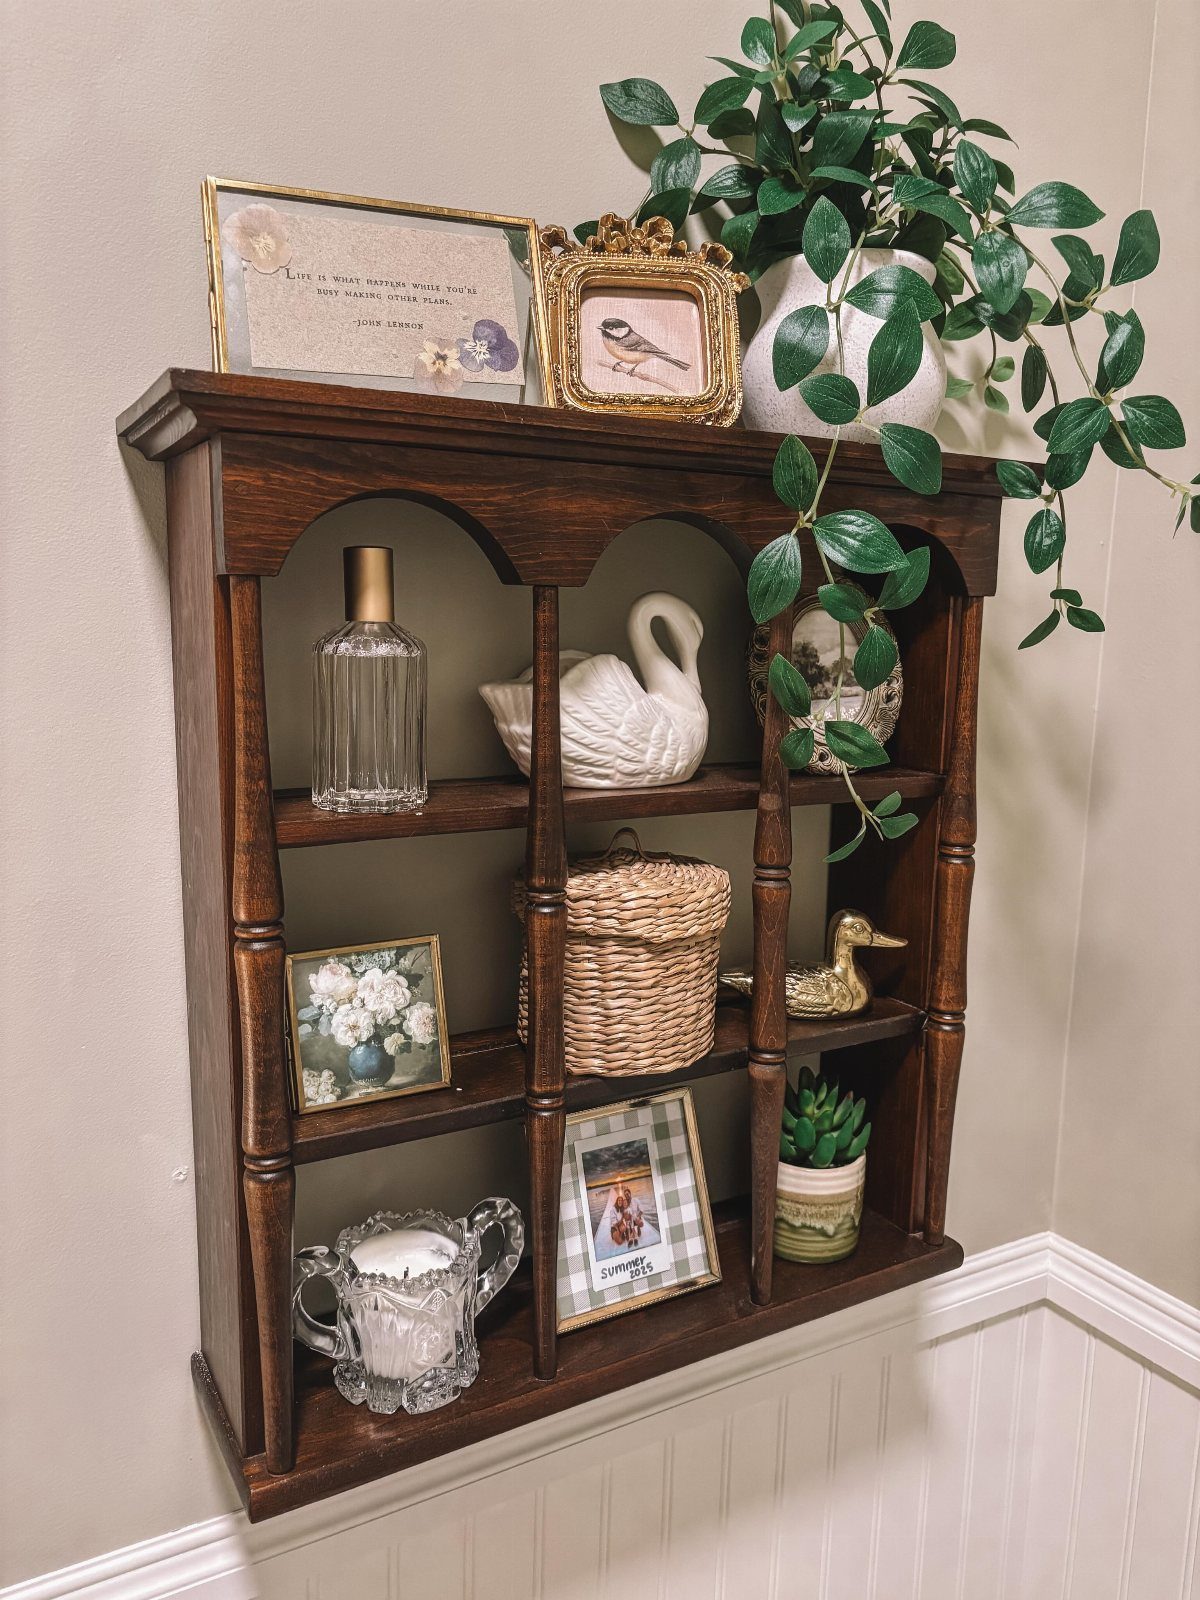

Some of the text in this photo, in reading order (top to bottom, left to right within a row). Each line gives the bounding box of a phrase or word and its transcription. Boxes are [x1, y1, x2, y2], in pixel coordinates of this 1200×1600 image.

[318, 274, 327, 282] IS
[332, 275, 361, 285] WHAT
[366, 278, 406, 288] HAPPENS
[412, 282, 441, 292] WHILE
[446, 285, 478, 295] YOU'RE
[316, 288, 453, 306] BUSY MAKING OTHER PLANS.
[387, 320, 424, 330] LENNON
[629, 1262, 654, 1279] 2025
